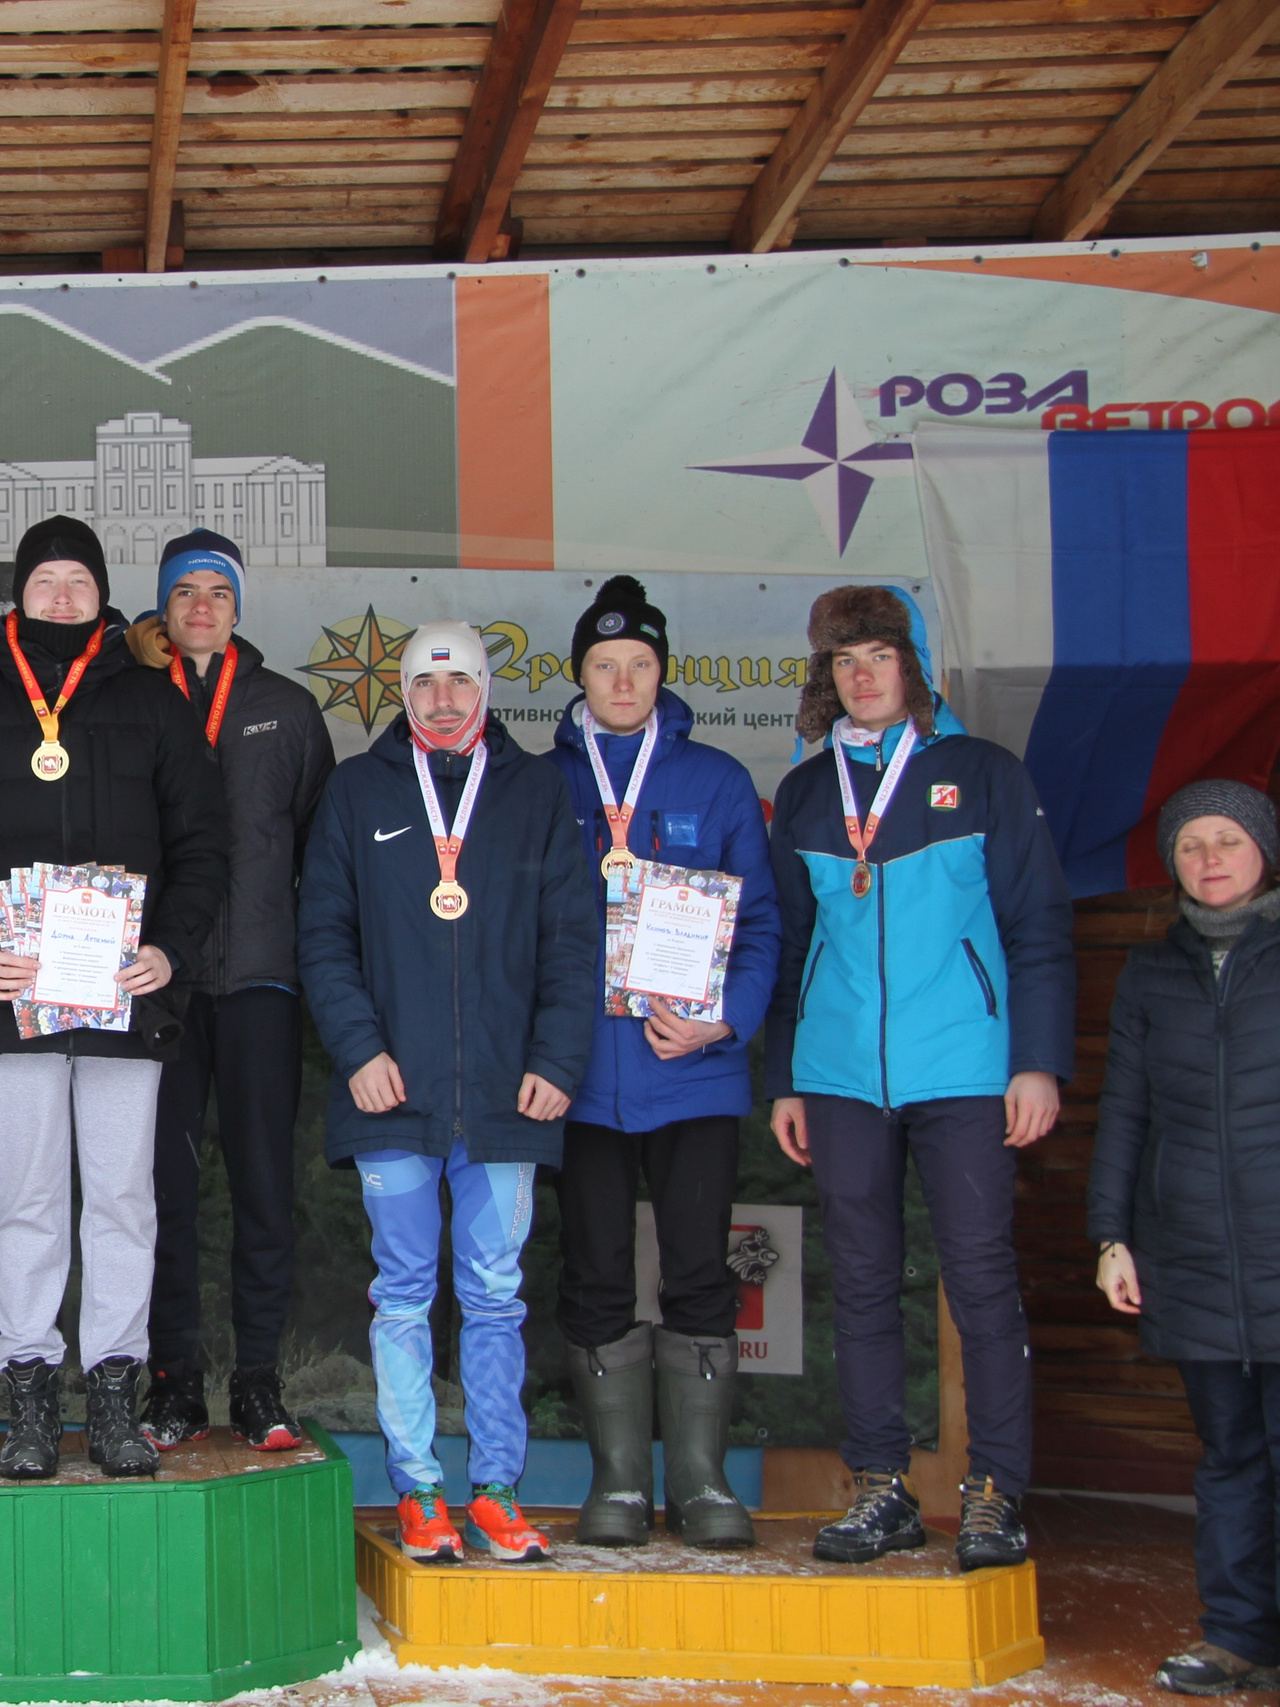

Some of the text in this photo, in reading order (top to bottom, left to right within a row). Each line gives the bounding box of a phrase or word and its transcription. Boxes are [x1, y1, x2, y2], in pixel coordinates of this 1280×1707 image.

[879, 370, 1088, 417] РОЗА
[1040, 398, 1280, 431] ВЕТРО
[188, 559, 226, 567] NORDSKI
[214, 658, 234, 709] ЧЕЛЯБИНСКАЯ
[587, 740, 609, 792] ЧЕЛЯБИНСКАЯ
[629, 757, 645, 792] ОБЛАСТЬ
[457, 771, 478, 824] ЧЕЛЯБИНСКАЯ
[878, 768, 897, 803] ОБЛАСТЬ
[425, 788, 439, 823] ОБЛАСТЬ
[53, 903, 116, 919] ГРАМОТА
[650, 898, 711, 917] ГРАМОТА
